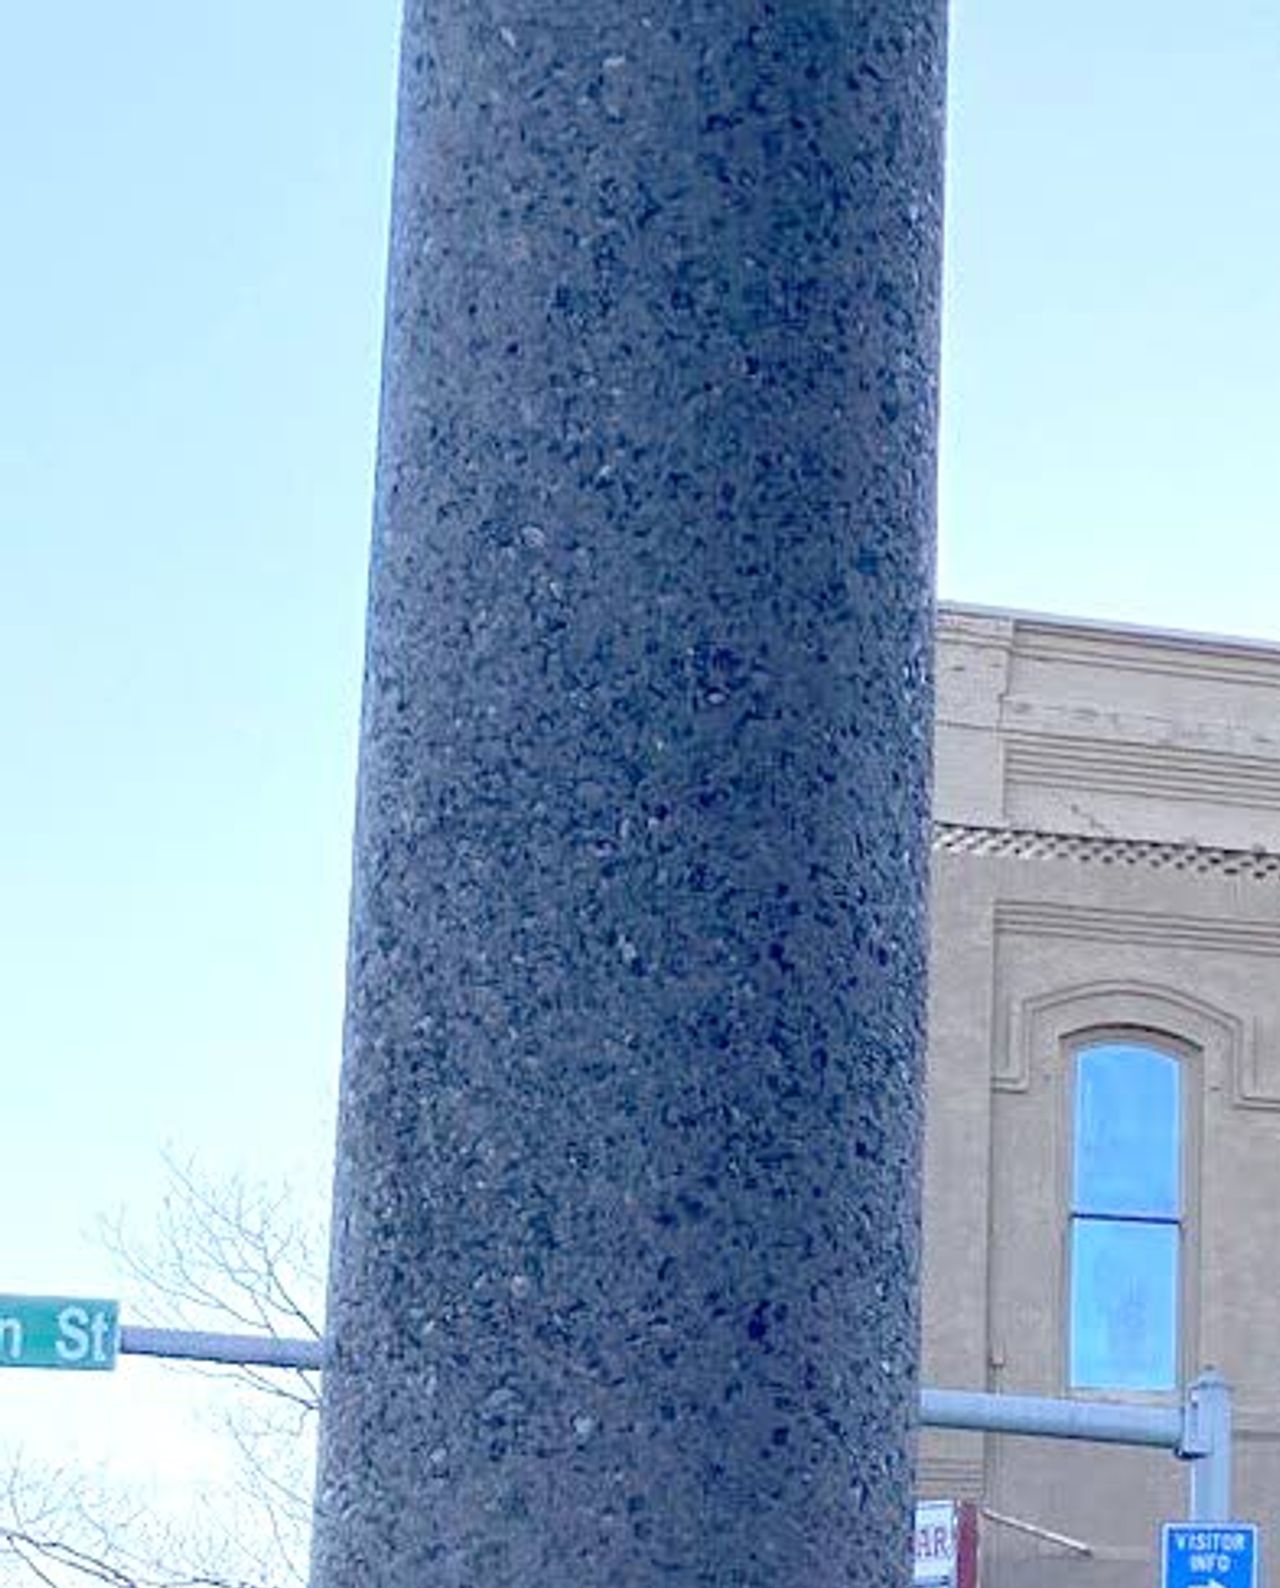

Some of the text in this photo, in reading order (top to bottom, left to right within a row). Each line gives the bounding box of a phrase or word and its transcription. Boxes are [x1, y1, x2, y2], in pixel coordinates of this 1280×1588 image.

[55, 1306, 108, 1361] St
[1175, 1533, 1244, 1550] VISITOR
[1191, 1554, 1231, 1573] INFO
